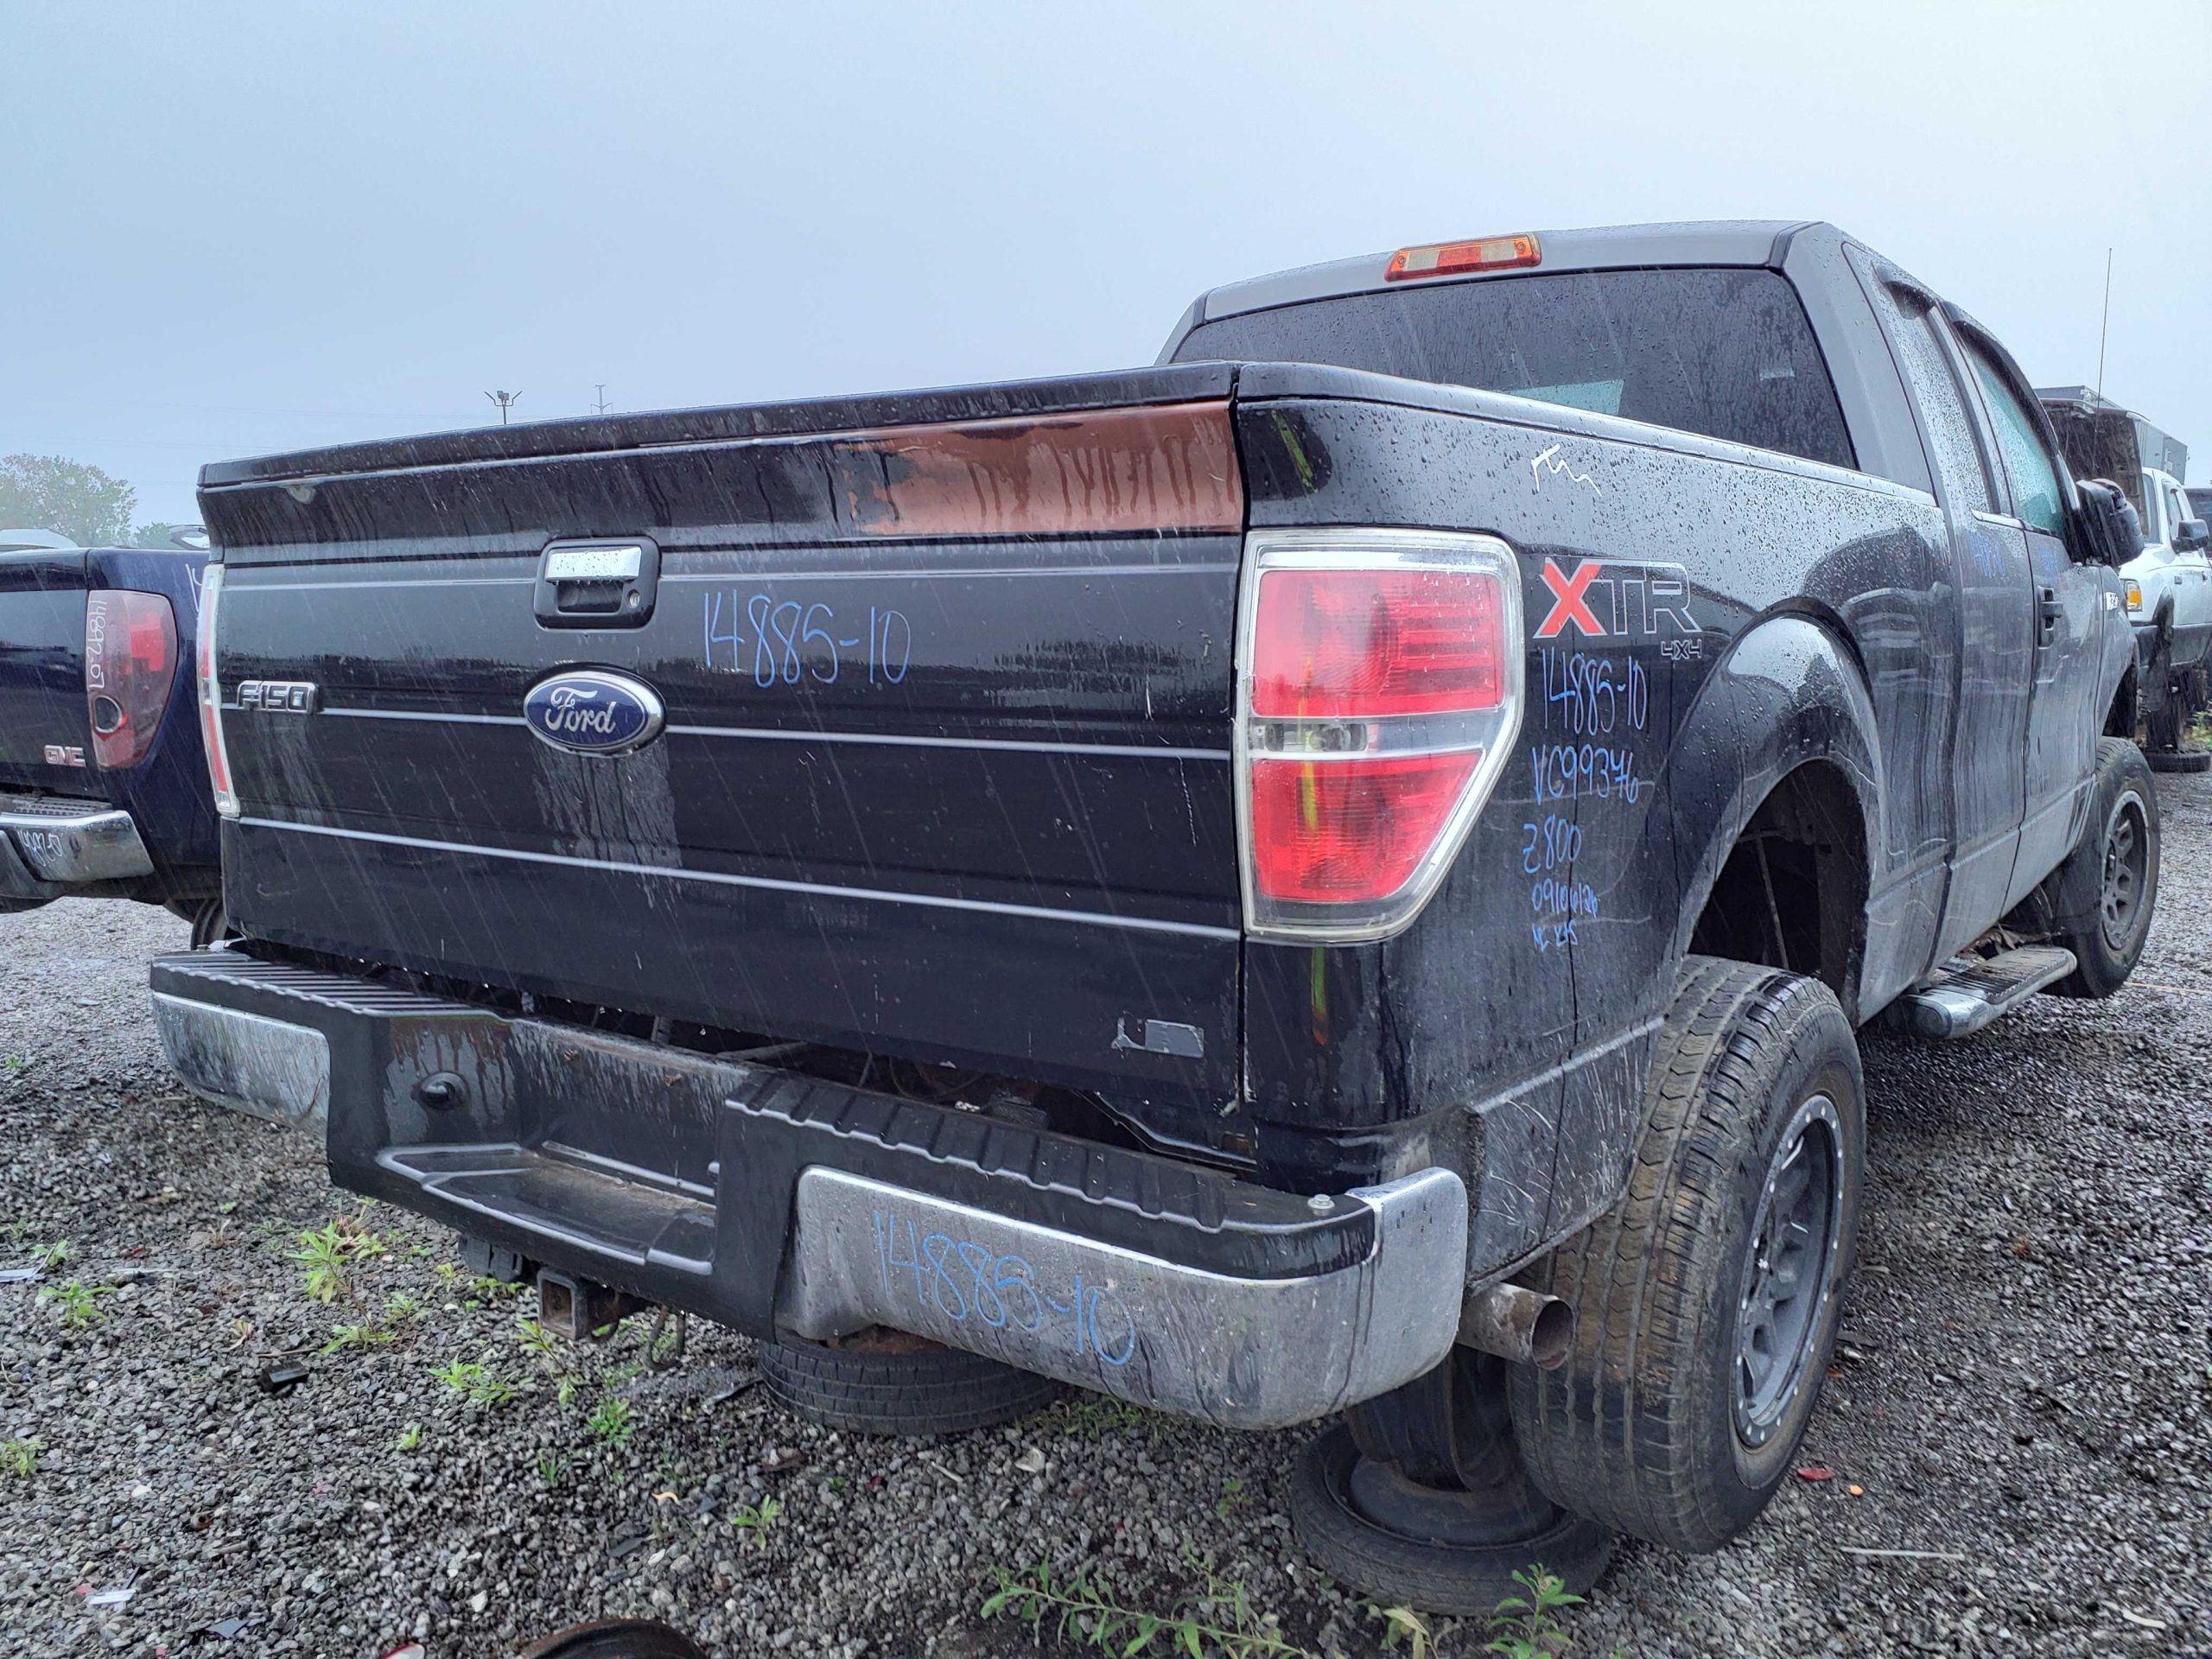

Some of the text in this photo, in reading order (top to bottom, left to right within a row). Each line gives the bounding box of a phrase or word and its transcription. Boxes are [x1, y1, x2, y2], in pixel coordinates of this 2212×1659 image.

[704, 588, 912, 689] 14885-10
[1532, 556, 1702, 639] XTR
[544, 688, 617, 734] Ford
[1541, 646, 1648, 735] 14885-10
[44, 745, 86, 768] GMC
[873, 1210, 1136, 1367] 14885-10
